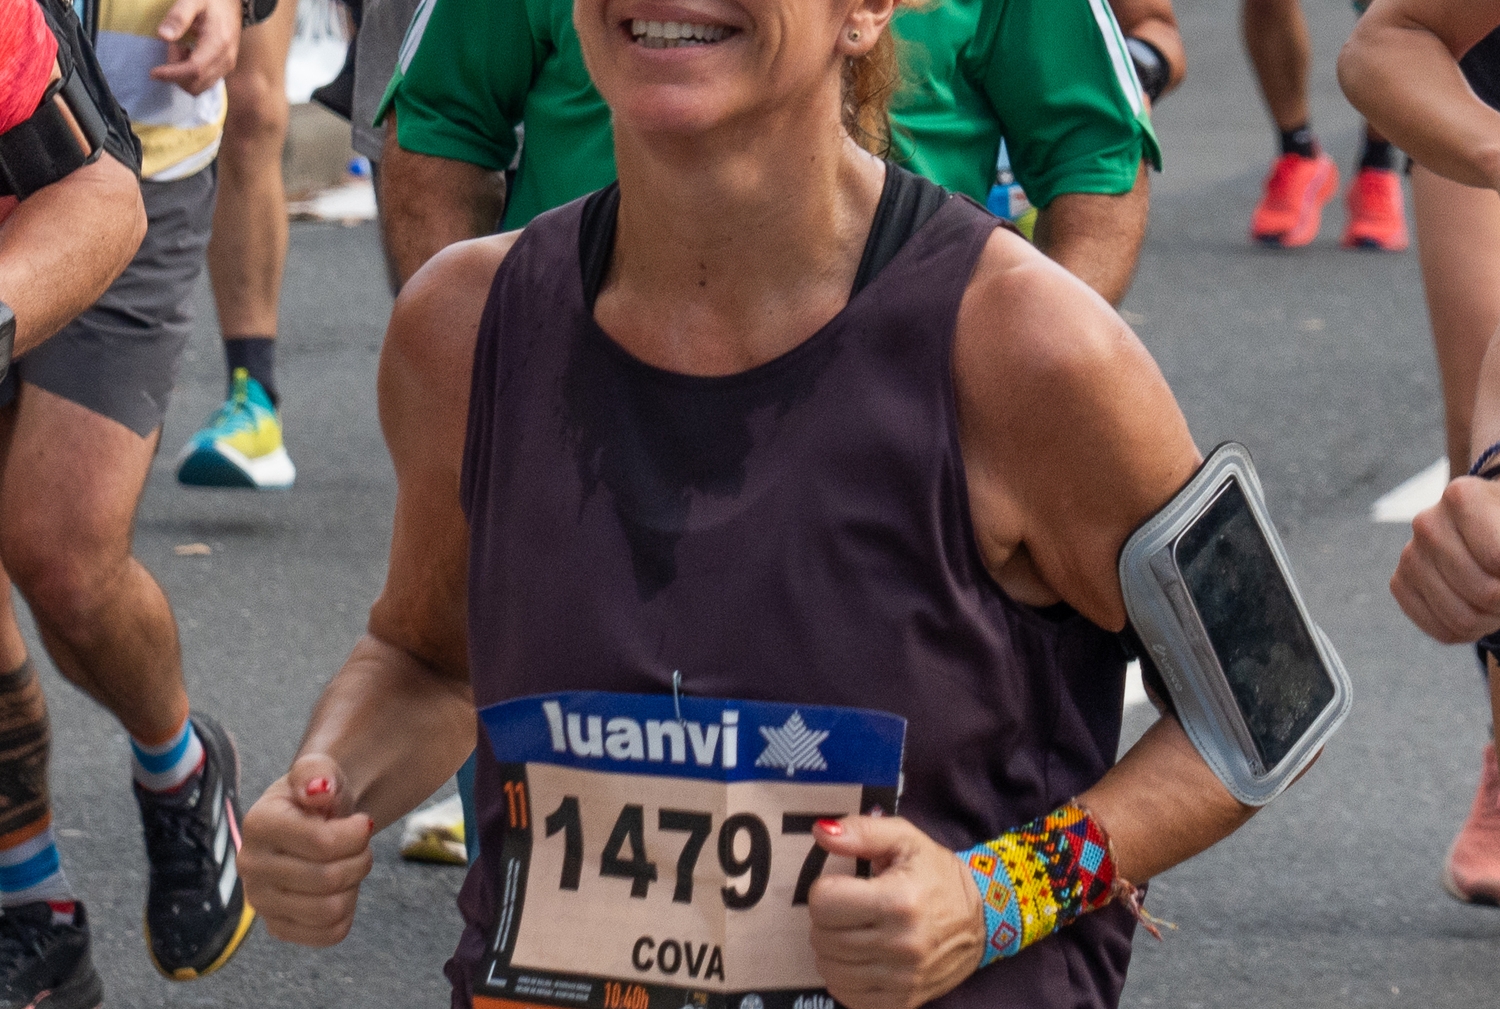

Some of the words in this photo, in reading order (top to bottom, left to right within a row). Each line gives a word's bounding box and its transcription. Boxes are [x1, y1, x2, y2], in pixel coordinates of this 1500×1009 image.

[542, 700, 739, 769] luanvi
[504, 780, 528, 829] 11
[545, 795, 852, 912] 14797
[632, 936, 726, 982] COVA
